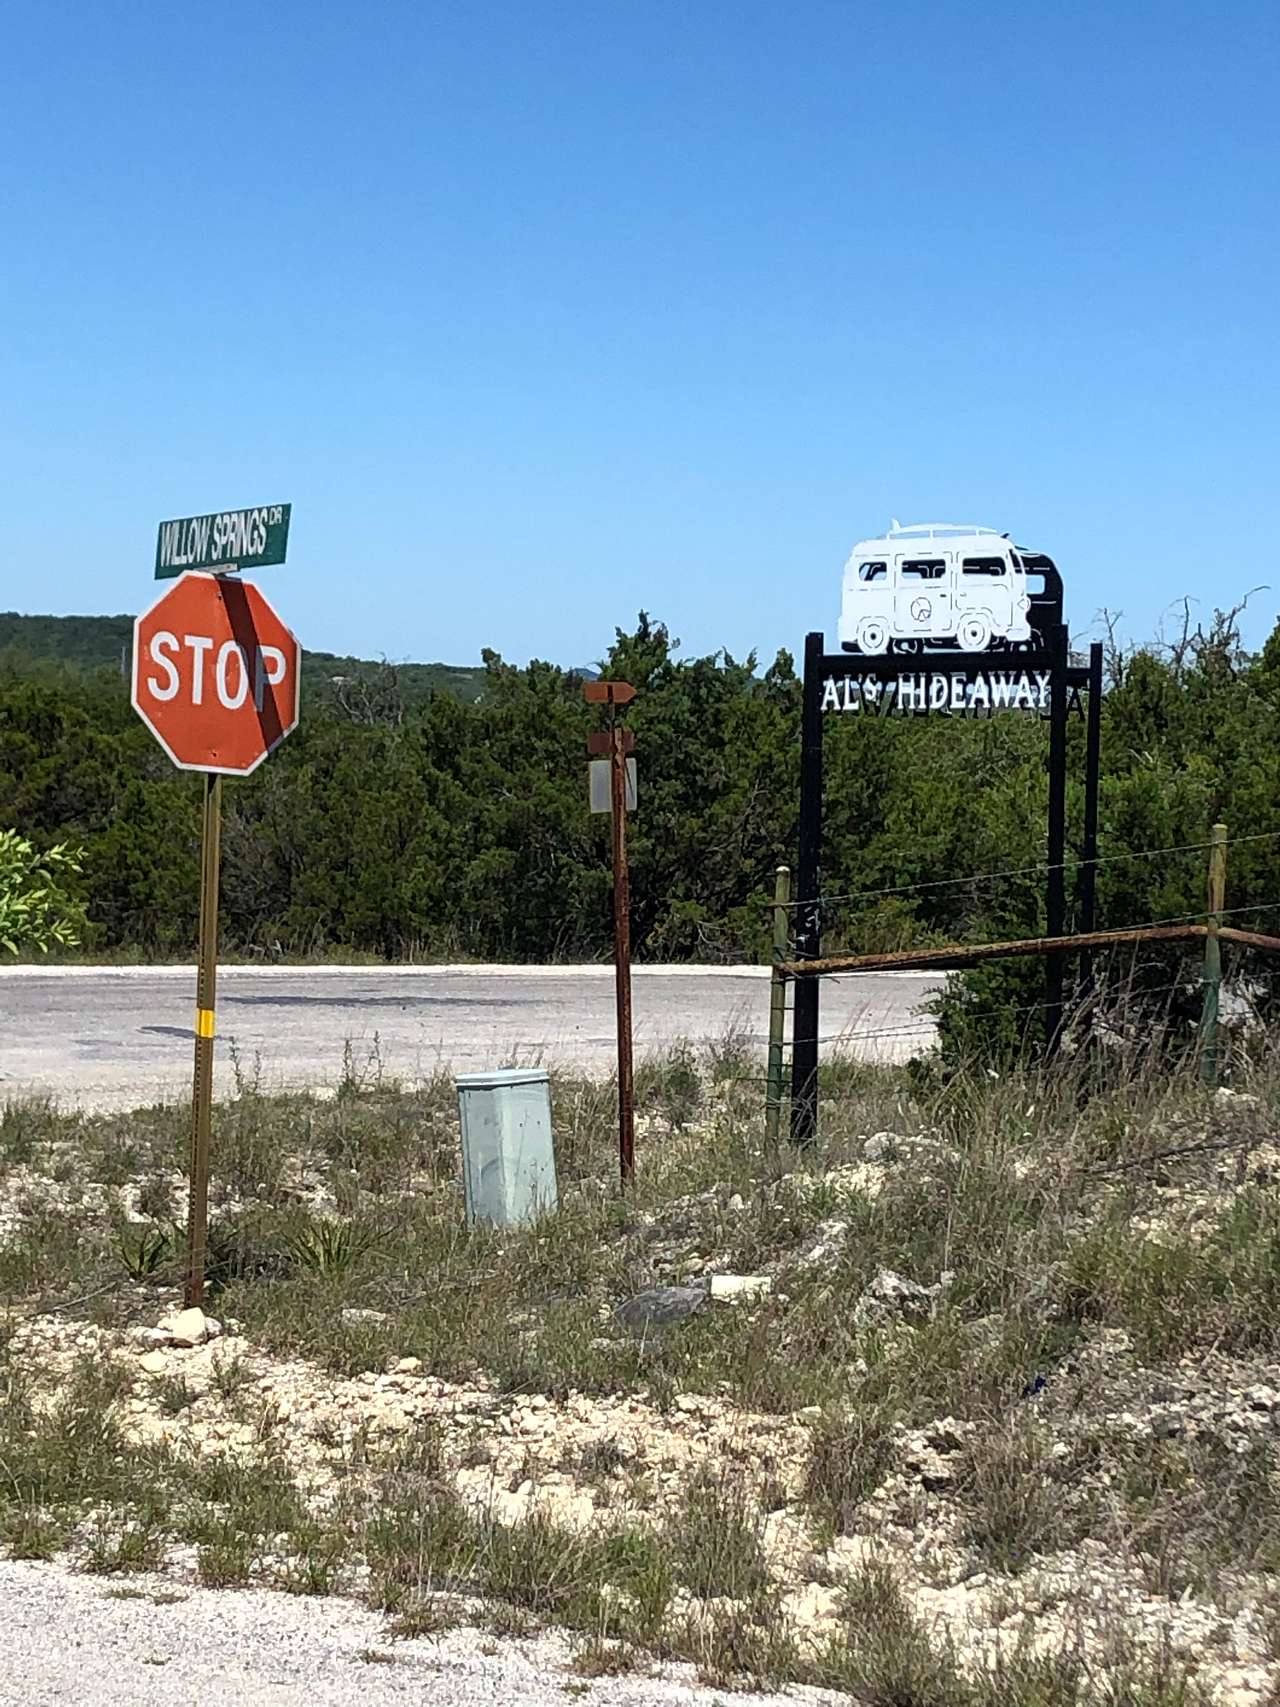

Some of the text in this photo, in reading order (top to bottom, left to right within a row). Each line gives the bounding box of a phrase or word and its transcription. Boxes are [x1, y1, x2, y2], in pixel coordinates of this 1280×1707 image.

[160, 506, 283, 567] WILLOW SPRINGS DR
[147, 630, 287, 713] STOP
[820, 674, 878, 711] AL'S
[897, 670, 1052, 710] HIDEAWAY
